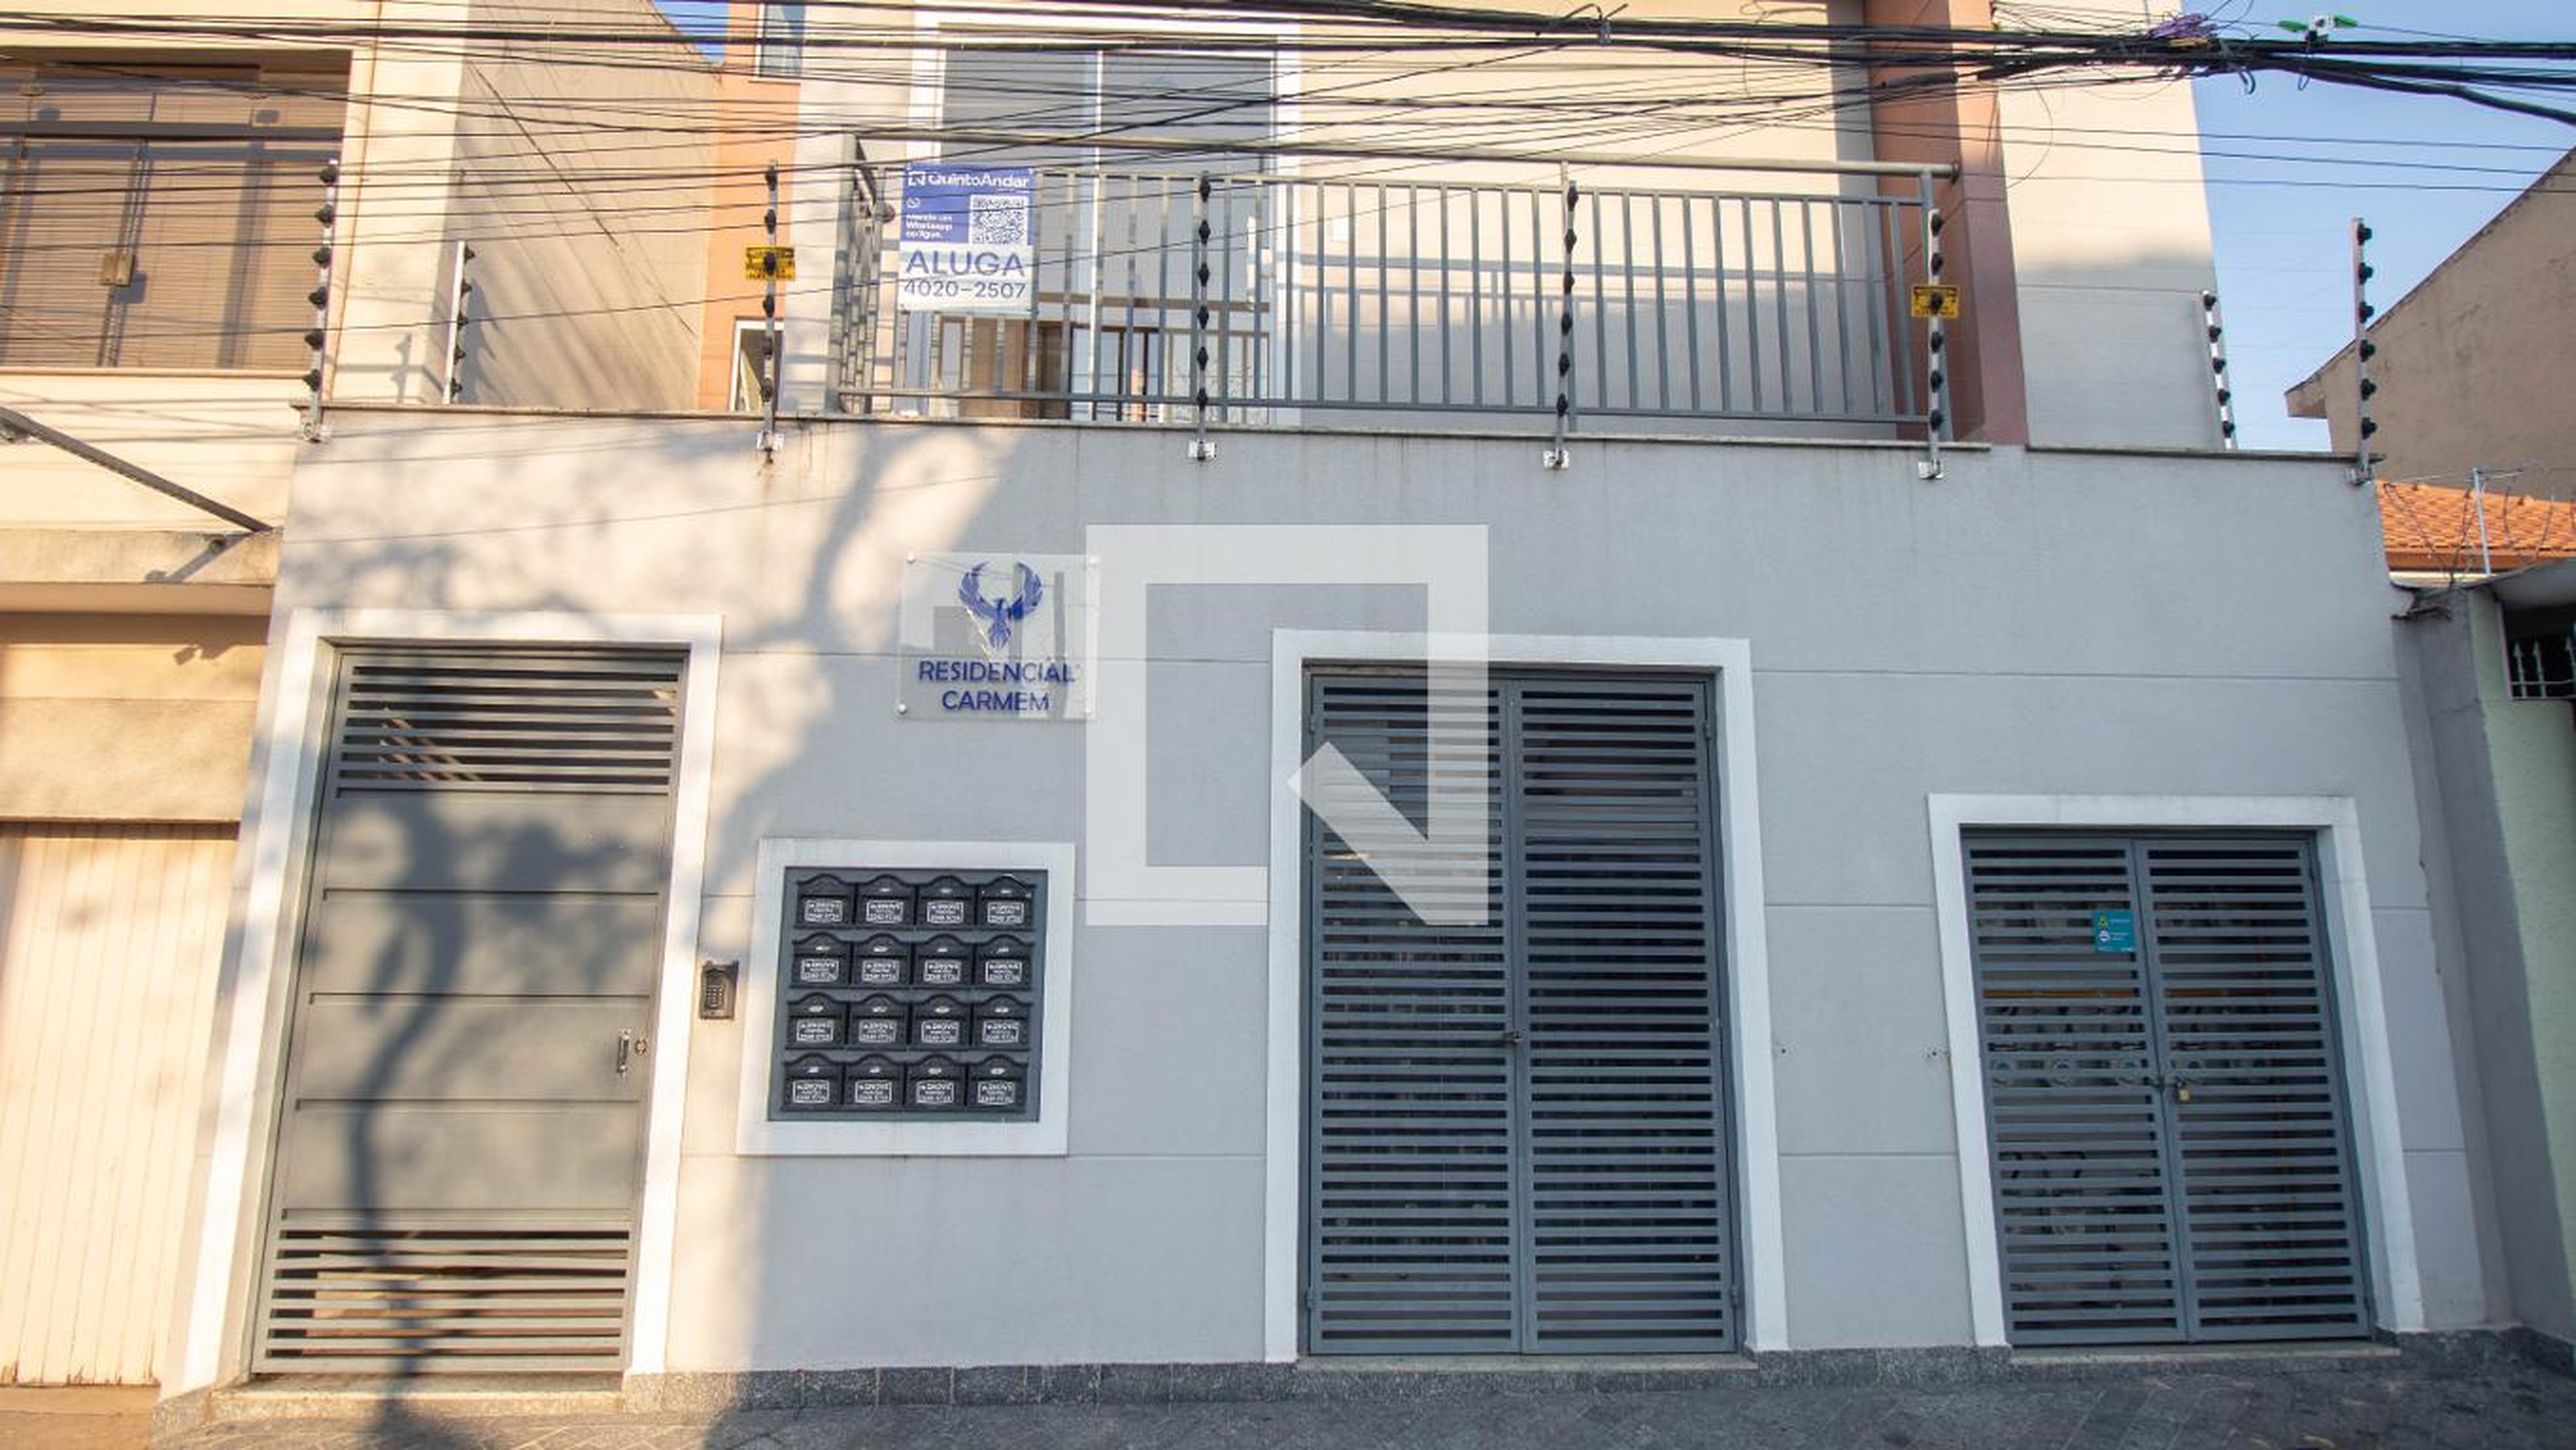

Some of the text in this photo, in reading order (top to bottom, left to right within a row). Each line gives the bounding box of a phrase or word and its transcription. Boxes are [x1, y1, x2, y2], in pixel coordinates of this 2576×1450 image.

[928, 173, 1030, 188] QuintoAndar
[906, 249, 1025, 277] ALUGA
[904, 279, 1026, 298] 4020-2507
[918, 661, 1075, 683] RESIDENCIAL
[942, 690, 1050, 710] CARMEM
